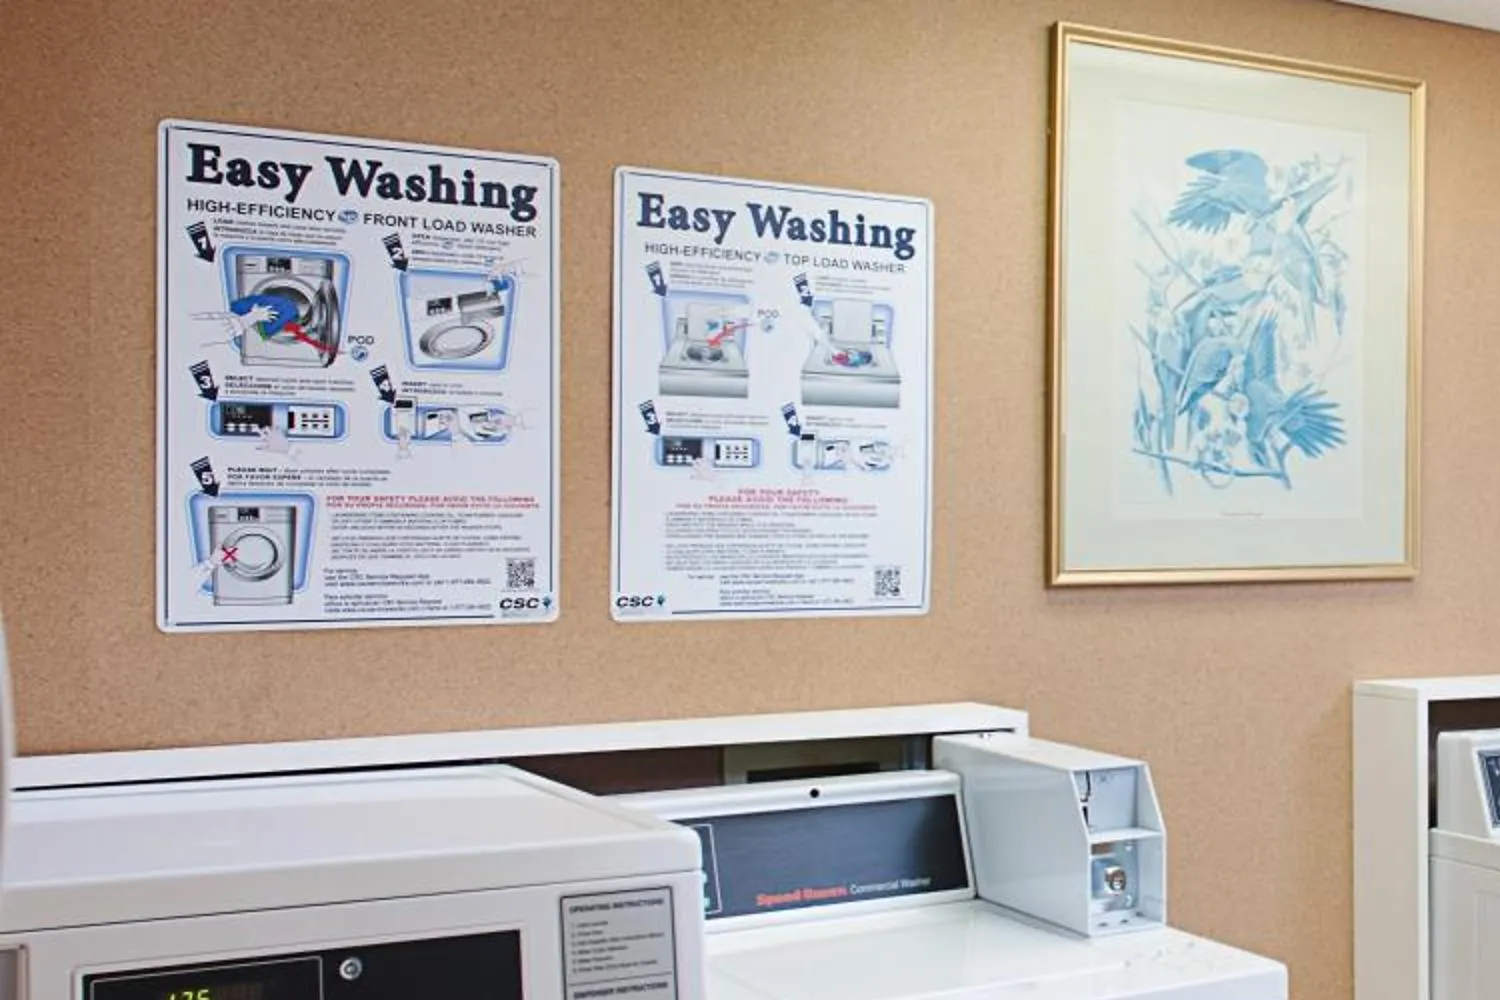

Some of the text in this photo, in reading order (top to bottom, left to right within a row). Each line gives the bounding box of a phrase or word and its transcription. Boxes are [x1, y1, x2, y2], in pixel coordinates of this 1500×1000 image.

[186, 143, 538, 222] Easy Washing
[187, 198, 538, 237] HIGH-EFFICIENCY FRONT LOAD WASHER
[637, 191, 916, 260] Easy Washing
[645, 242, 905, 274] HIGH-EFFICIENCY TOP LOAD WASHER
[500, 597, 539, 609] CSC
[616, 595, 653, 608] CSC
